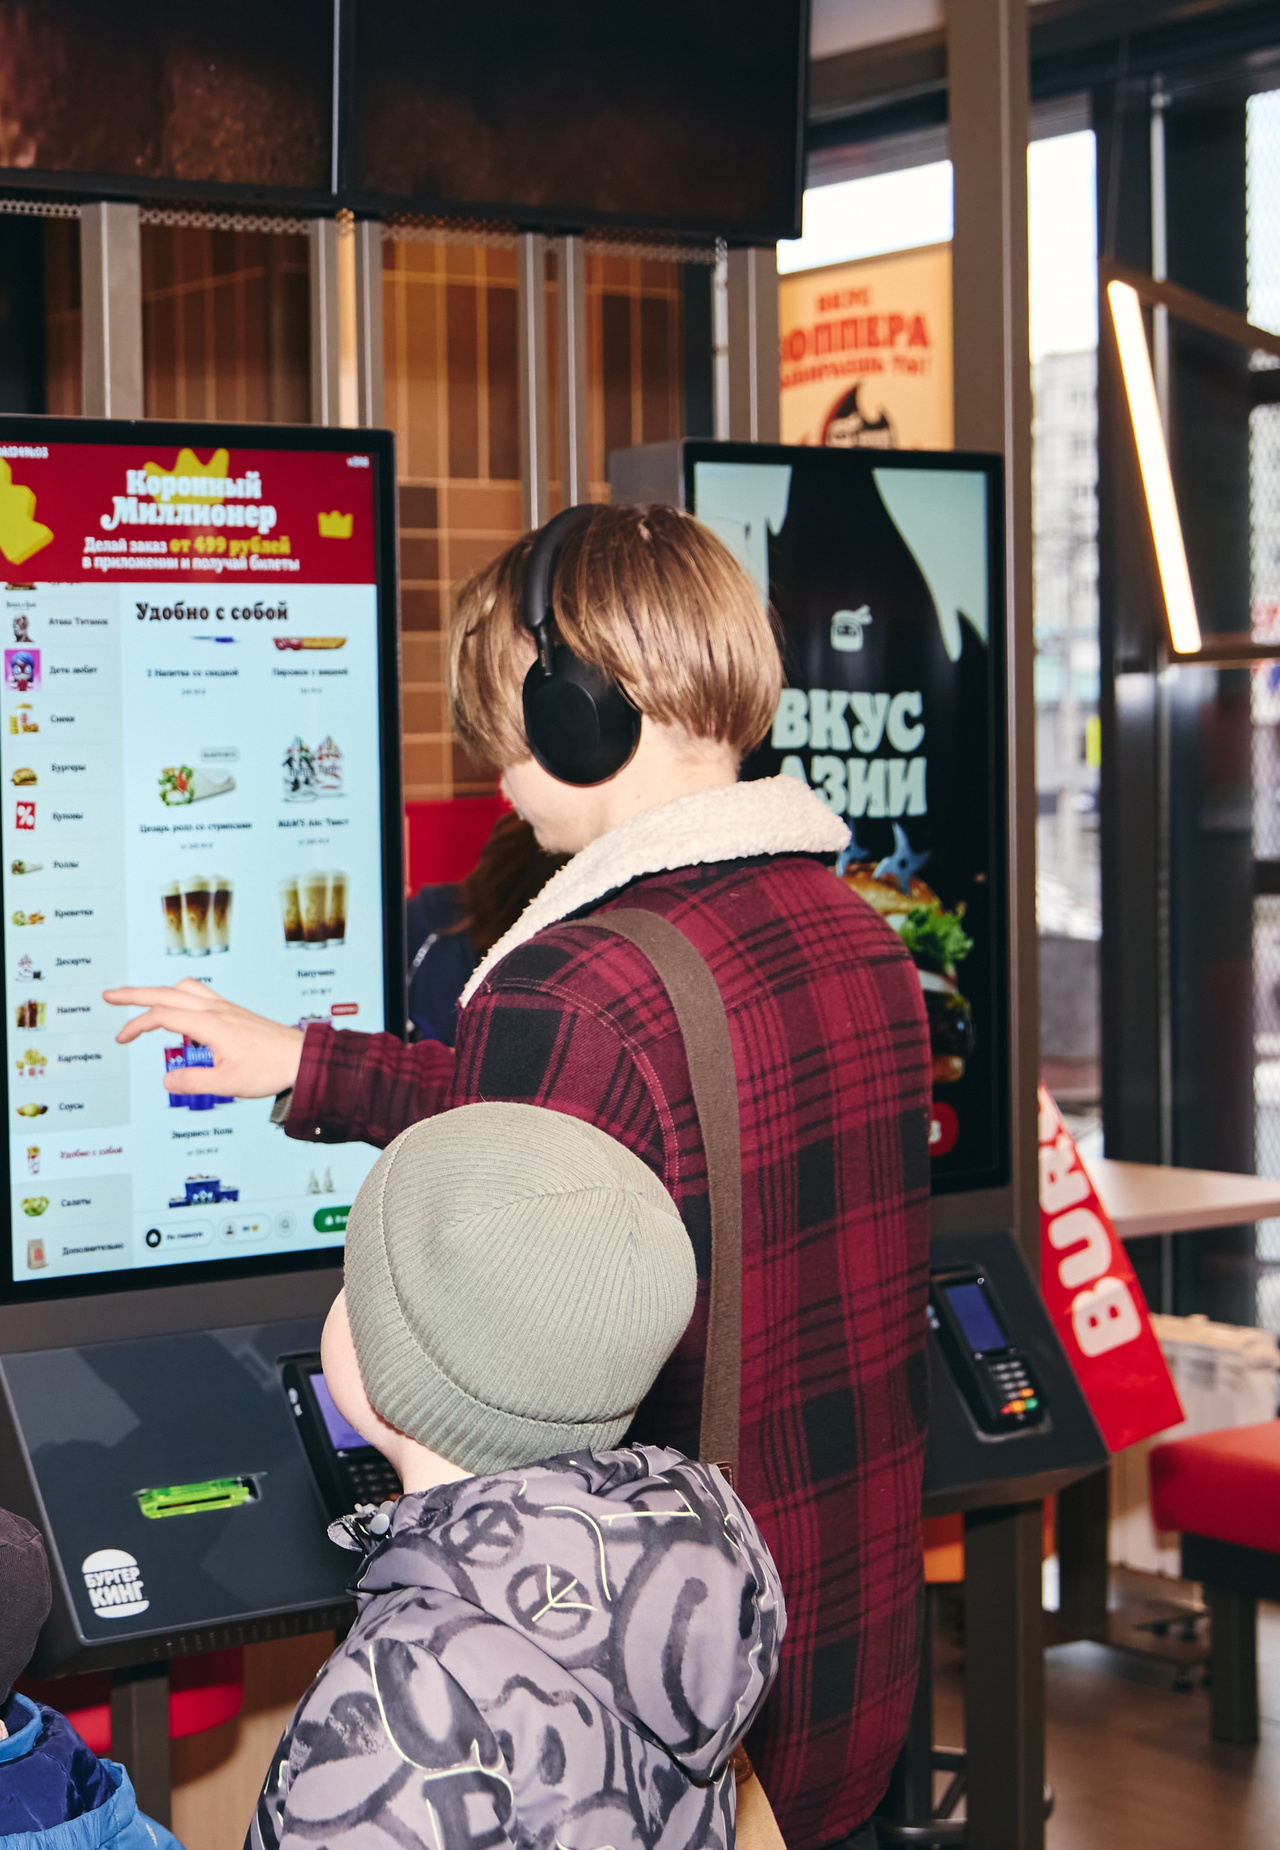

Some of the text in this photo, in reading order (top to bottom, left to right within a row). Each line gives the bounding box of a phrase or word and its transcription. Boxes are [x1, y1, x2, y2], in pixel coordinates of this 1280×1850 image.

[126, 469, 262, 502] Коронный
[100, 496, 277, 535] Миллионер
[83, 535, 291, 557] Делай заказ от 499 рублей
[82, 554, 300, 573] в приложении и получай билеты
[136, 600, 288, 621] Удобно с собой
[771, 688, 925, 752] ВКУС
[84, 1567, 141, 1588] БУРГЕР
[88, 1581, 145, 1609] КИНГ
